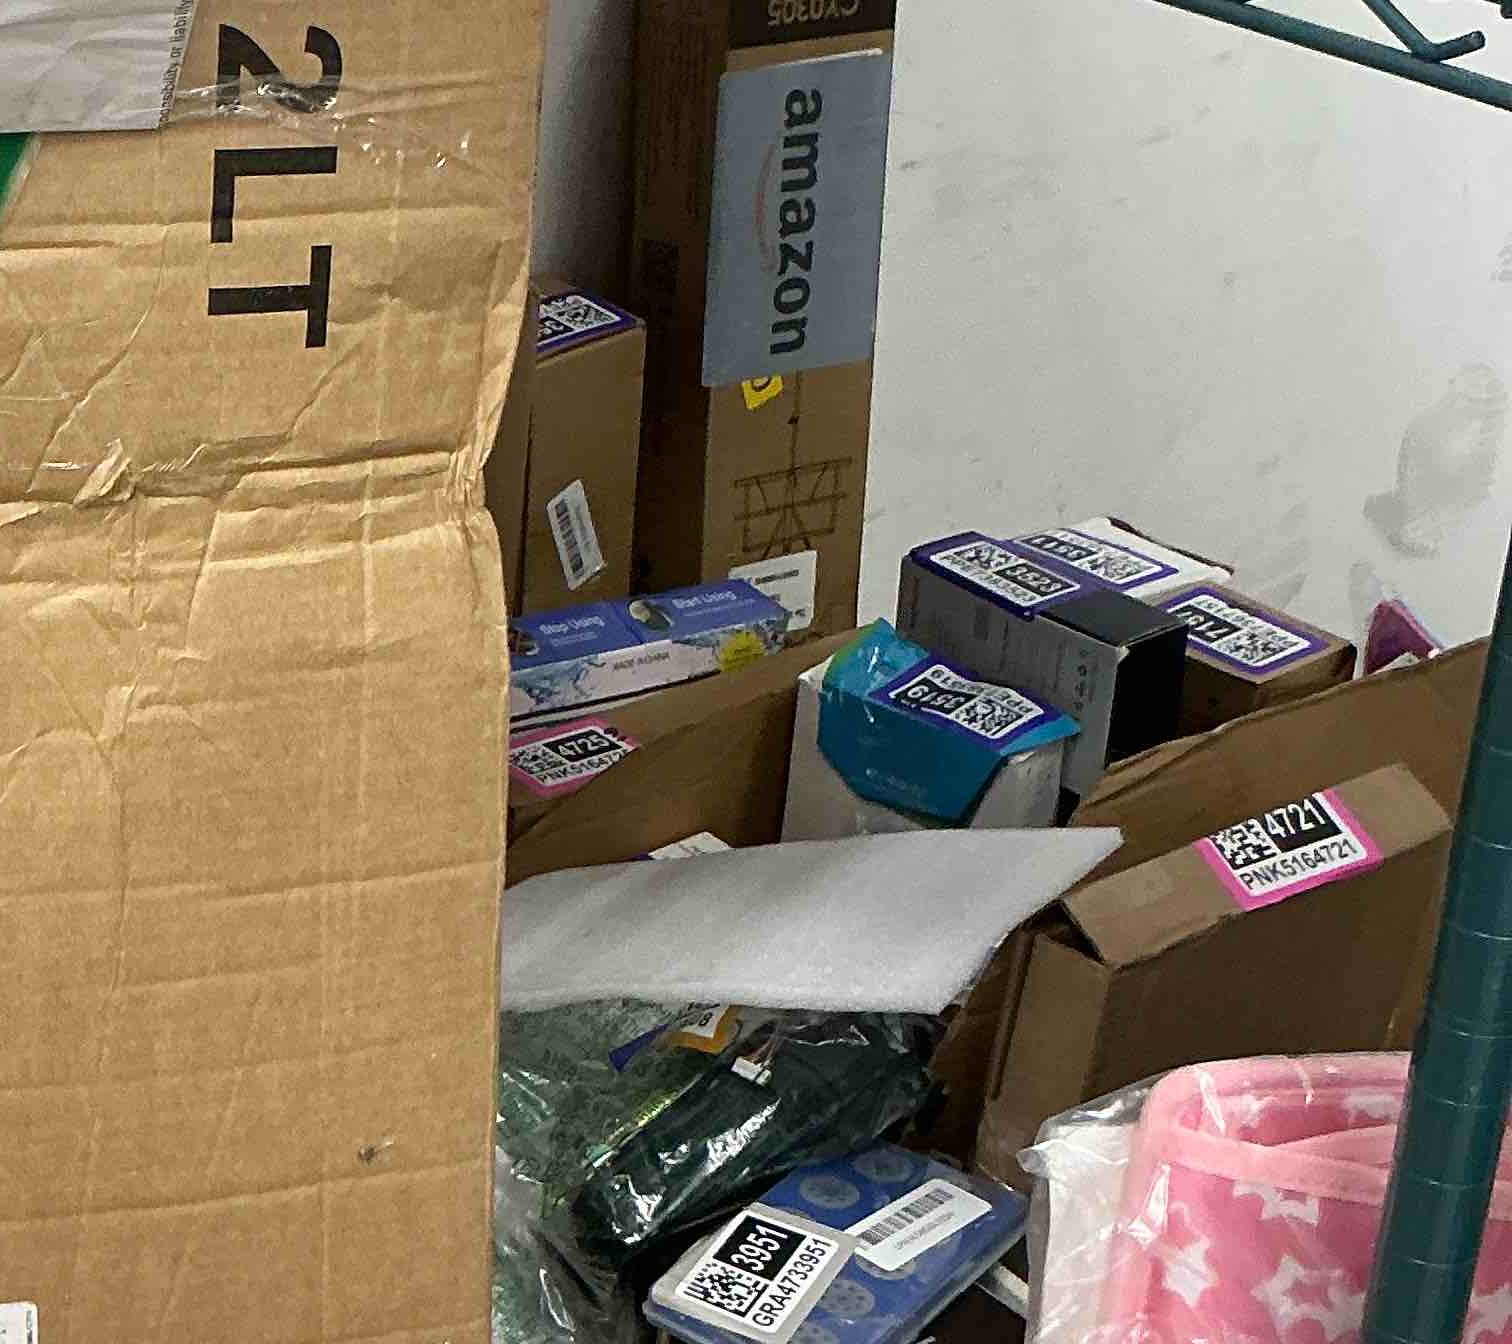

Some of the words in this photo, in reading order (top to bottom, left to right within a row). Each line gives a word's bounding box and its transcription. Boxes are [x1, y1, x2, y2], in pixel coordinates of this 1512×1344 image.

[769, 86, 825, 356] amazon
[556, 732, 611, 759] 4725
[1263, 798, 1327, 839] 4721
[1239, 838, 1358, 891] PNK5164721
[728, 1223, 789, 1275] 3951
[752, 1237, 834, 1328] GRA4733951
